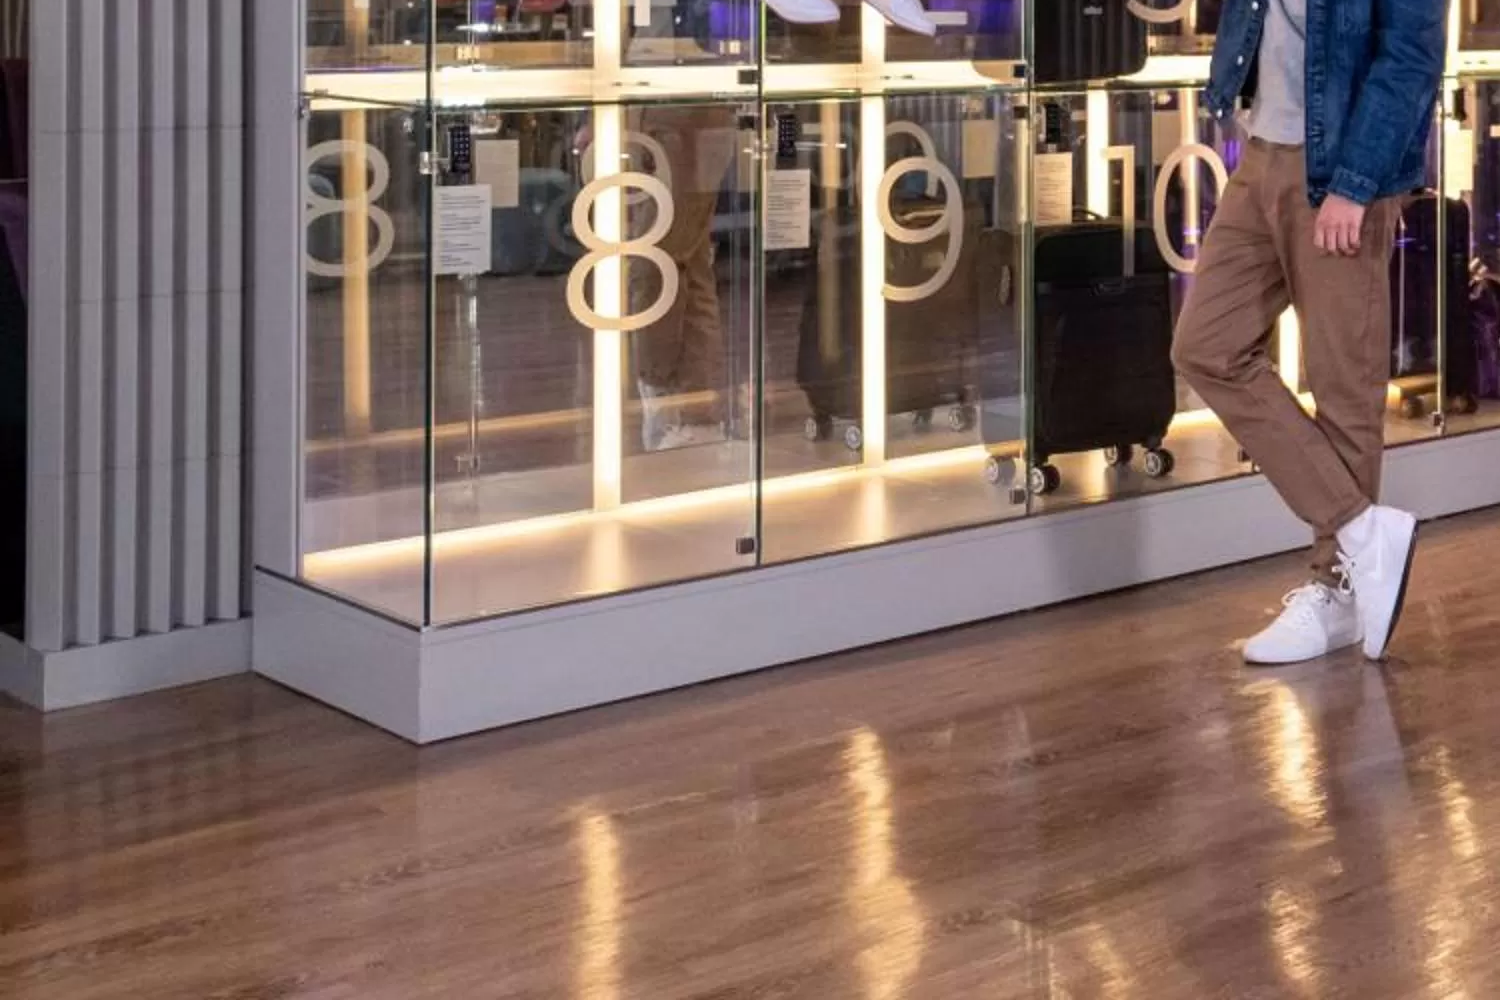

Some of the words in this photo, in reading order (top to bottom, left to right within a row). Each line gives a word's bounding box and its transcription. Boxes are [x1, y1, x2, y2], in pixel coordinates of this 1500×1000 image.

[306, 139, 395, 277] 8
[567, 171, 679, 332] 8
[878, 156, 962, 302] 9
[1102, 143, 1228, 277] 10
